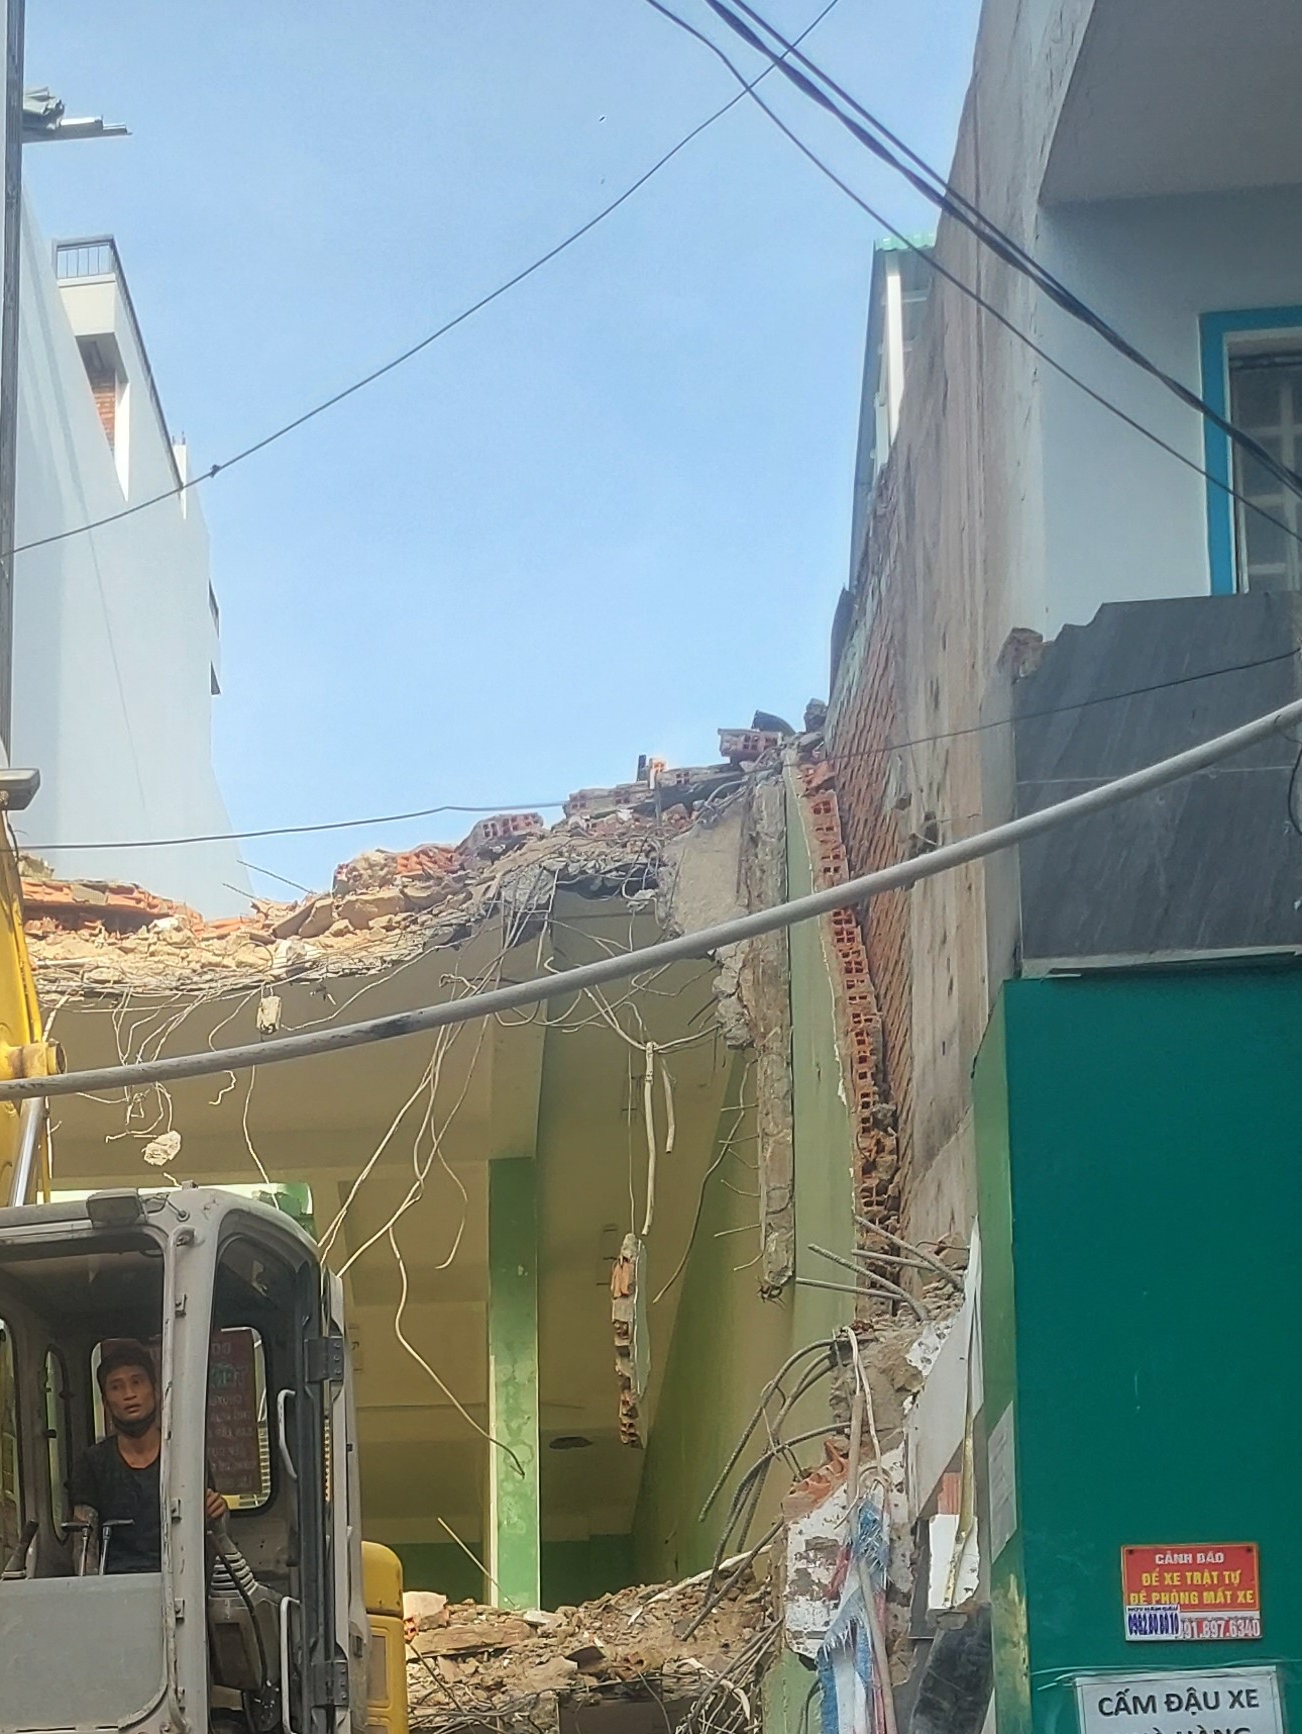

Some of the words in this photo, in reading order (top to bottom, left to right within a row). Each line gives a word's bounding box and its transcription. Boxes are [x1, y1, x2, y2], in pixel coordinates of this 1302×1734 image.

[1155, 1551, 1192, 1565] CẢNH
[1197, 1551, 1224, 1564] BÁO
[1164, 1573, 1181, 1585] XE
[1186, 1569, 1218, 1587] TRẬT
[1223, 1569, 1242, 1587] TỰ
[1152, 1589, 1198, 1605] PHÒNG
[1203, 1587, 1232, 1604] MẤT
[1238, 1591, 1255, 1603] XE
[1098, 1688, 1158, 1716] CẤM
[1164, 1687, 1220, 1715] ĐẬU
[1228, 1689, 1259, 1709] XE
